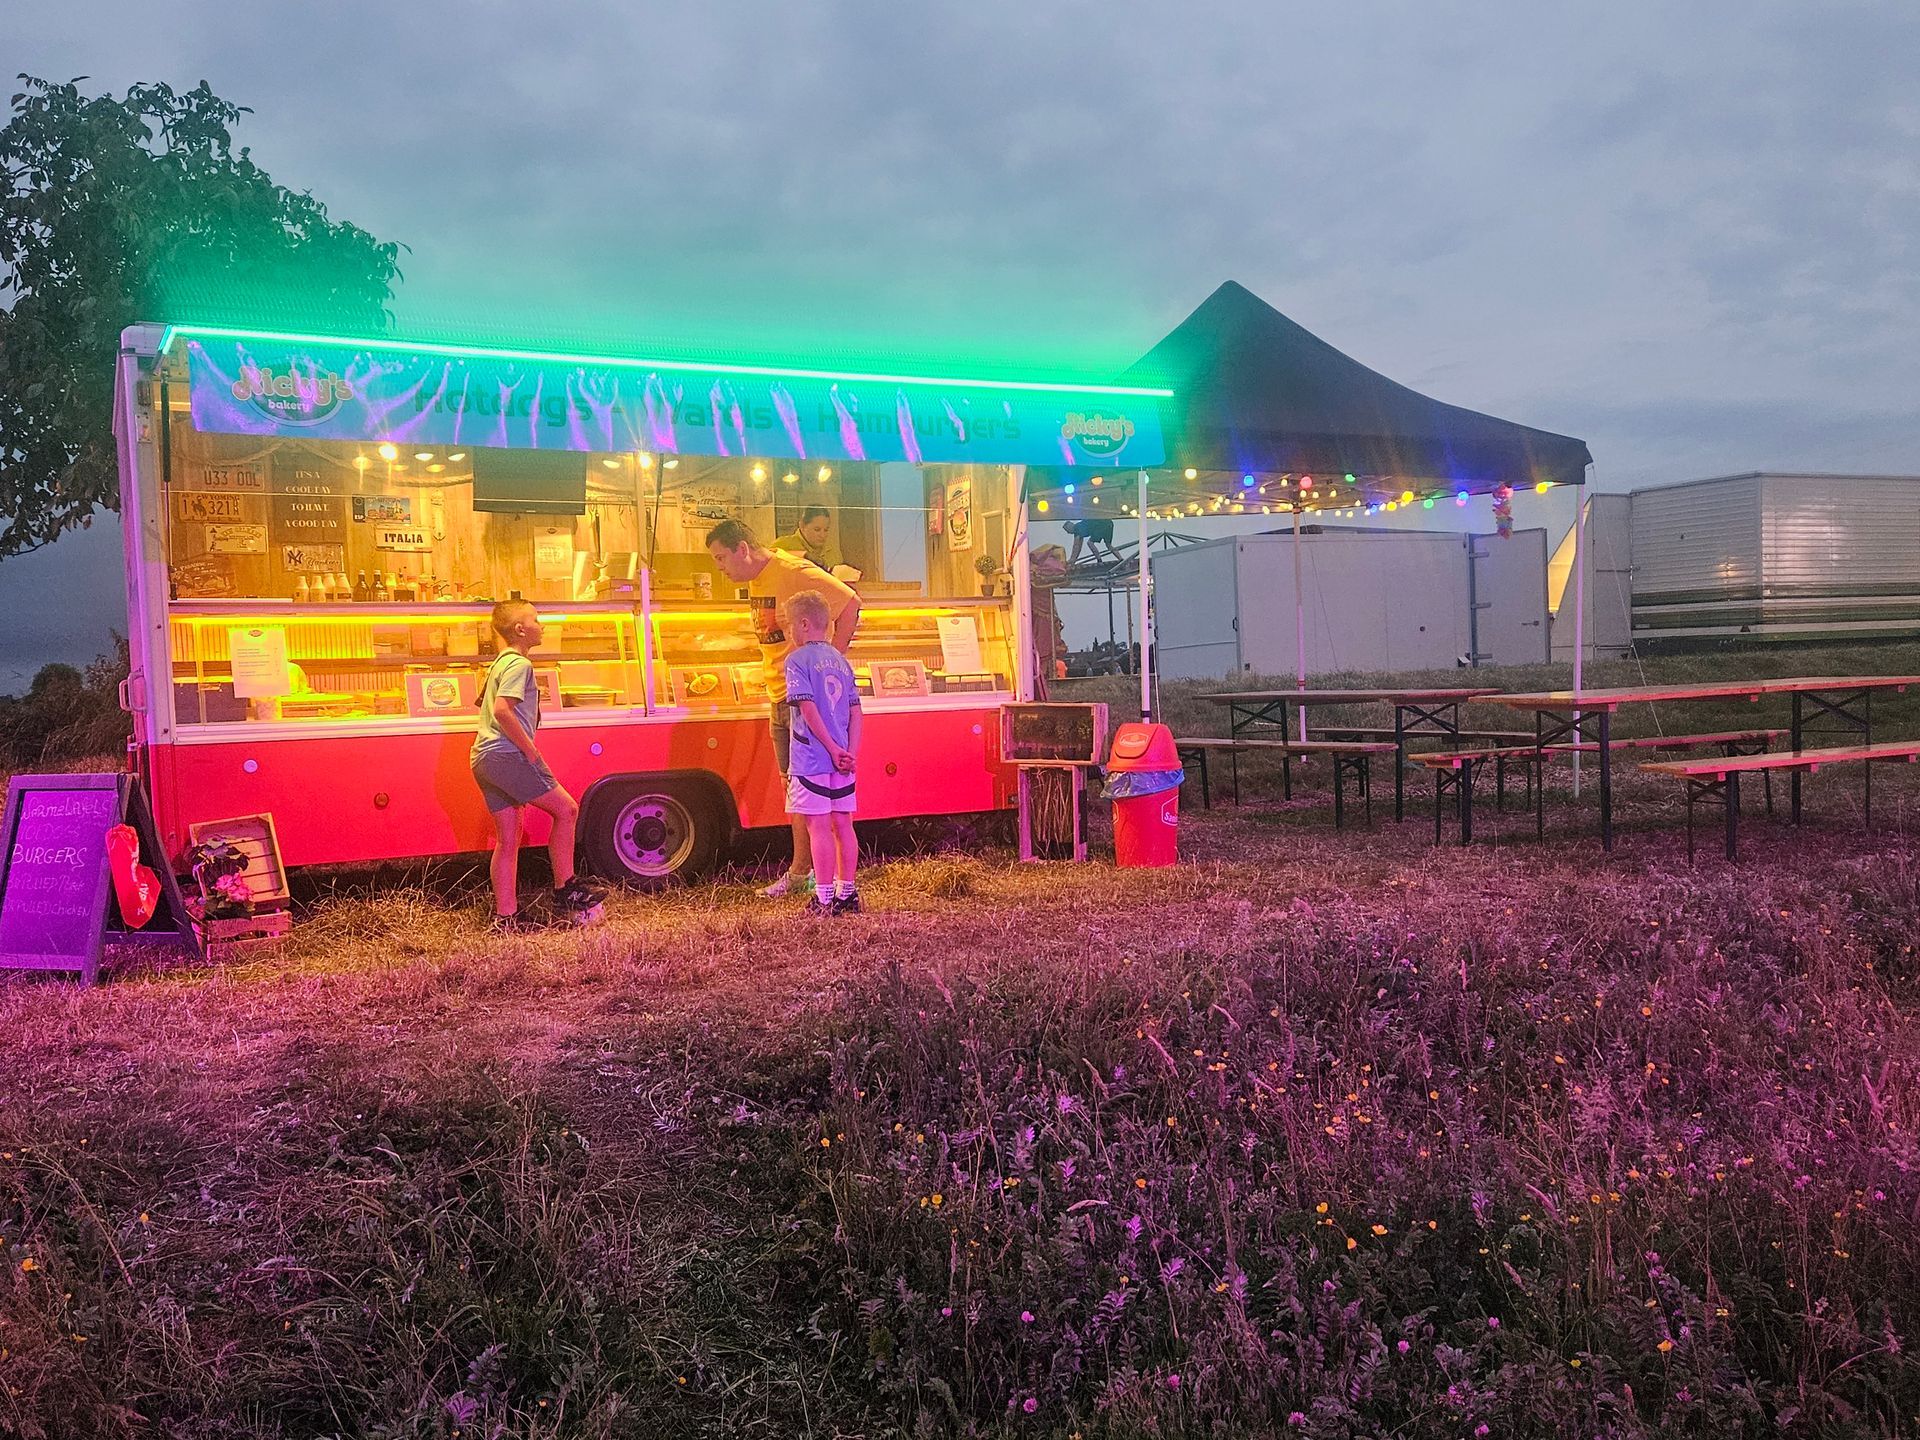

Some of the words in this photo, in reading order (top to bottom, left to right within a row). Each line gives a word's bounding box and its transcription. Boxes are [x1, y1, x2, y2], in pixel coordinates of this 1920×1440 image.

[268, 398, 310, 412] bakery
[414, 380, 593, 428] Hotdogs
[1083, 437, 1110, 447] bakery
[208, 500, 230, 516] 321
[384, 533, 424, 543] ITALIA
[287, 550, 304, 566] NY
[824, 674, 843, 711] 9
[12, 843, 88, 872] BURGERS
